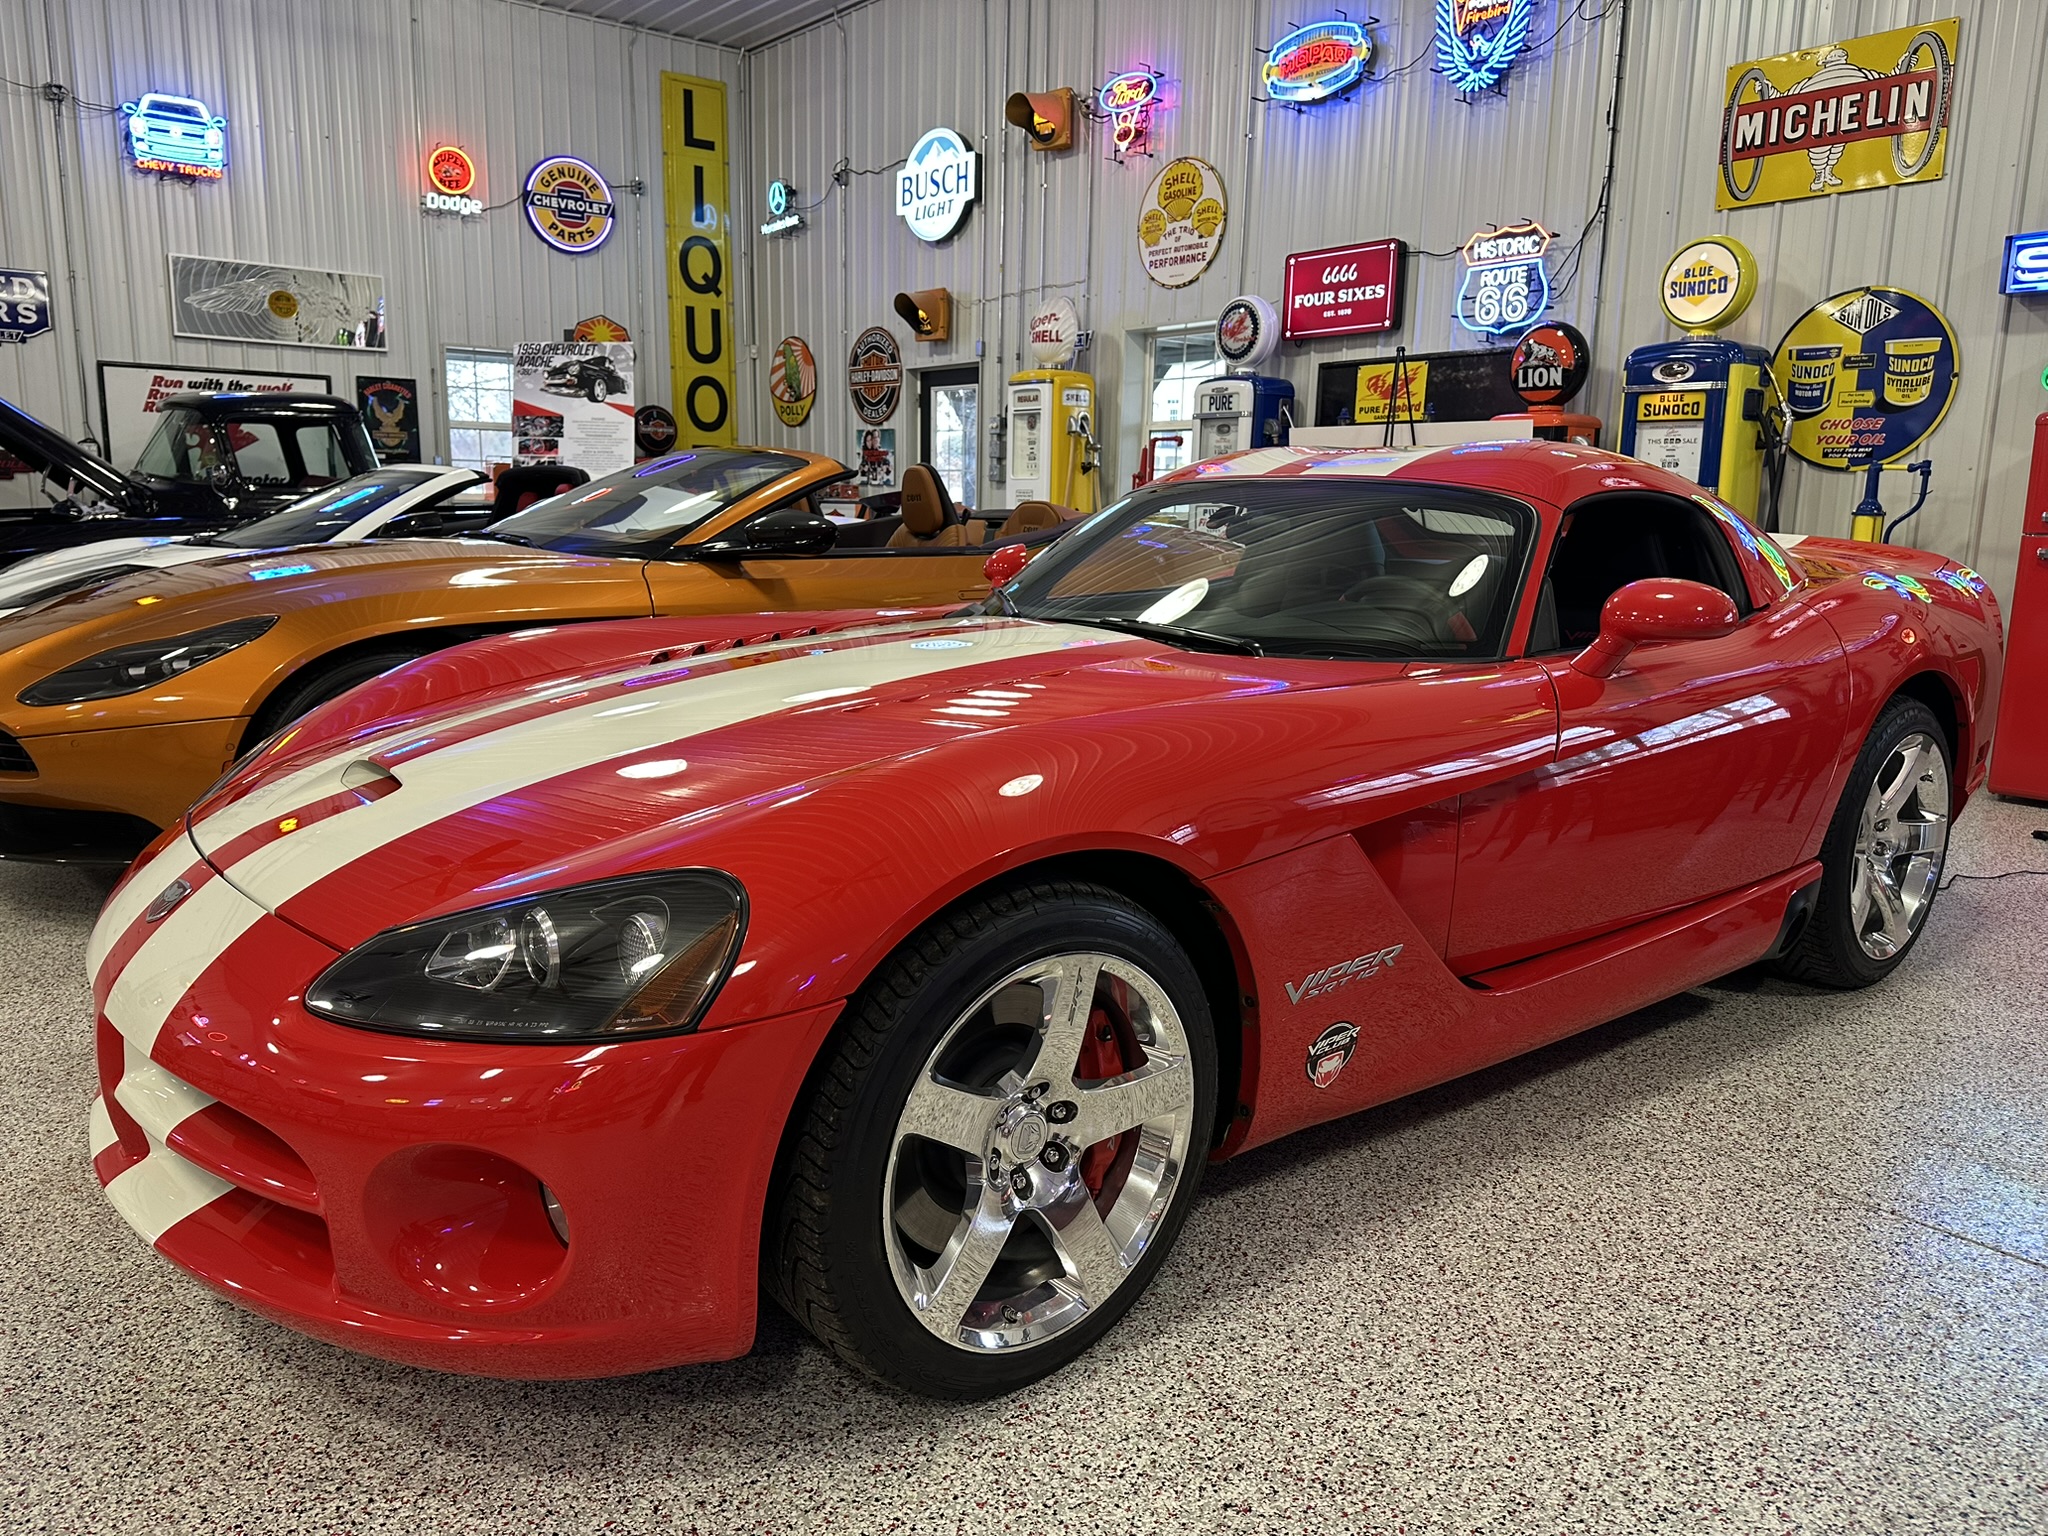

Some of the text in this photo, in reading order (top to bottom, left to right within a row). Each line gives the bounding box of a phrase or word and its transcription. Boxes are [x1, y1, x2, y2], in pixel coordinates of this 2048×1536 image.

[1466, 1, 1511, 24] Firebird
[1278, 42, 1354, 80] MOPAR
[1108, 79, 1150, 108] Ford
[1735, 79, 1932, 151] MICHELIN
[136, 160, 222, 179] CHEVY TRUCKS
[540, 166, 599, 195] GENUINE
[902, 160, 969, 207] BUSCH
[1165, 172, 1197, 190] SHELL
[1163, 185, 1197, 201] GASOLINE
[426, 192, 483, 216] Dodge
[533, 194, 607, 215] CHEVROLET
[915, 198, 955, 221] LIGHT
[1197, 205, 1218, 217] SHELL
[548, 221, 596, 243] PARTS
[1163, 227, 1177, 240] THE
[1149, 241, 1208, 258] PERFECT AUTOMOBILE
[1473, 235, 1541, 260] HISTORIC
[1149, 251, 1207, 270] PERFORMANCE
[1322, 262, 1358, 285] 6666
[1480, 265, 1529, 288] ROUTE
[1684, 265, 1714, 279] BLUE
[1294, 283, 1385, 309] FOUR SIXES
[1670, 275, 1728, 299] SUNOCO
[1474, 282, 1529, 325] 66
[1839, 298, 1892, 329] SUN OILS
[857, 332, 893, 354] AUTHORIZED
[1032, 329, 1063, 344] SHELL
[517, 343, 598, 356] 1959 CHEVROLET
[516, 355, 555, 368] APACHE
[1791, 362, 1835, 379] SUNOCO
[1888, 355, 1935, 372] SUNOCO
[151, 375, 183, 389] Run
[187, 378, 224, 391] with
[227, 380, 254, 391] the
[851, 369, 898, 383] HARLEY-DAVIDSON
[1518, 367, 1563, 388] LION
[1886, 375, 1931, 388] DYNALUBE
[1017, 394, 1039, 403] REGULAR
[1209, 394, 1234, 411] PURE
[1659, 394, 1685, 403] BLUE
[1813, 389, 1821, 397] OIL
[780, 404, 806, 417] POLLY
[863, 404, 888, 418] DEALER
[1358, 405, 1381, 415] PURE
[1643, 401, 1700, 418] SUNOCO
[1819, 417, 1886, 431] CHOOSE
[1816, 432, 1886, 446] YOUR OIL
[1285, 943, 1404, 1006] VIPER
[1304, 966, 1380, 1001] SRT 10
[1308, 1026, 1362, 1057] VIPER
[1316, 1037, 1351, 1056] CLUB
